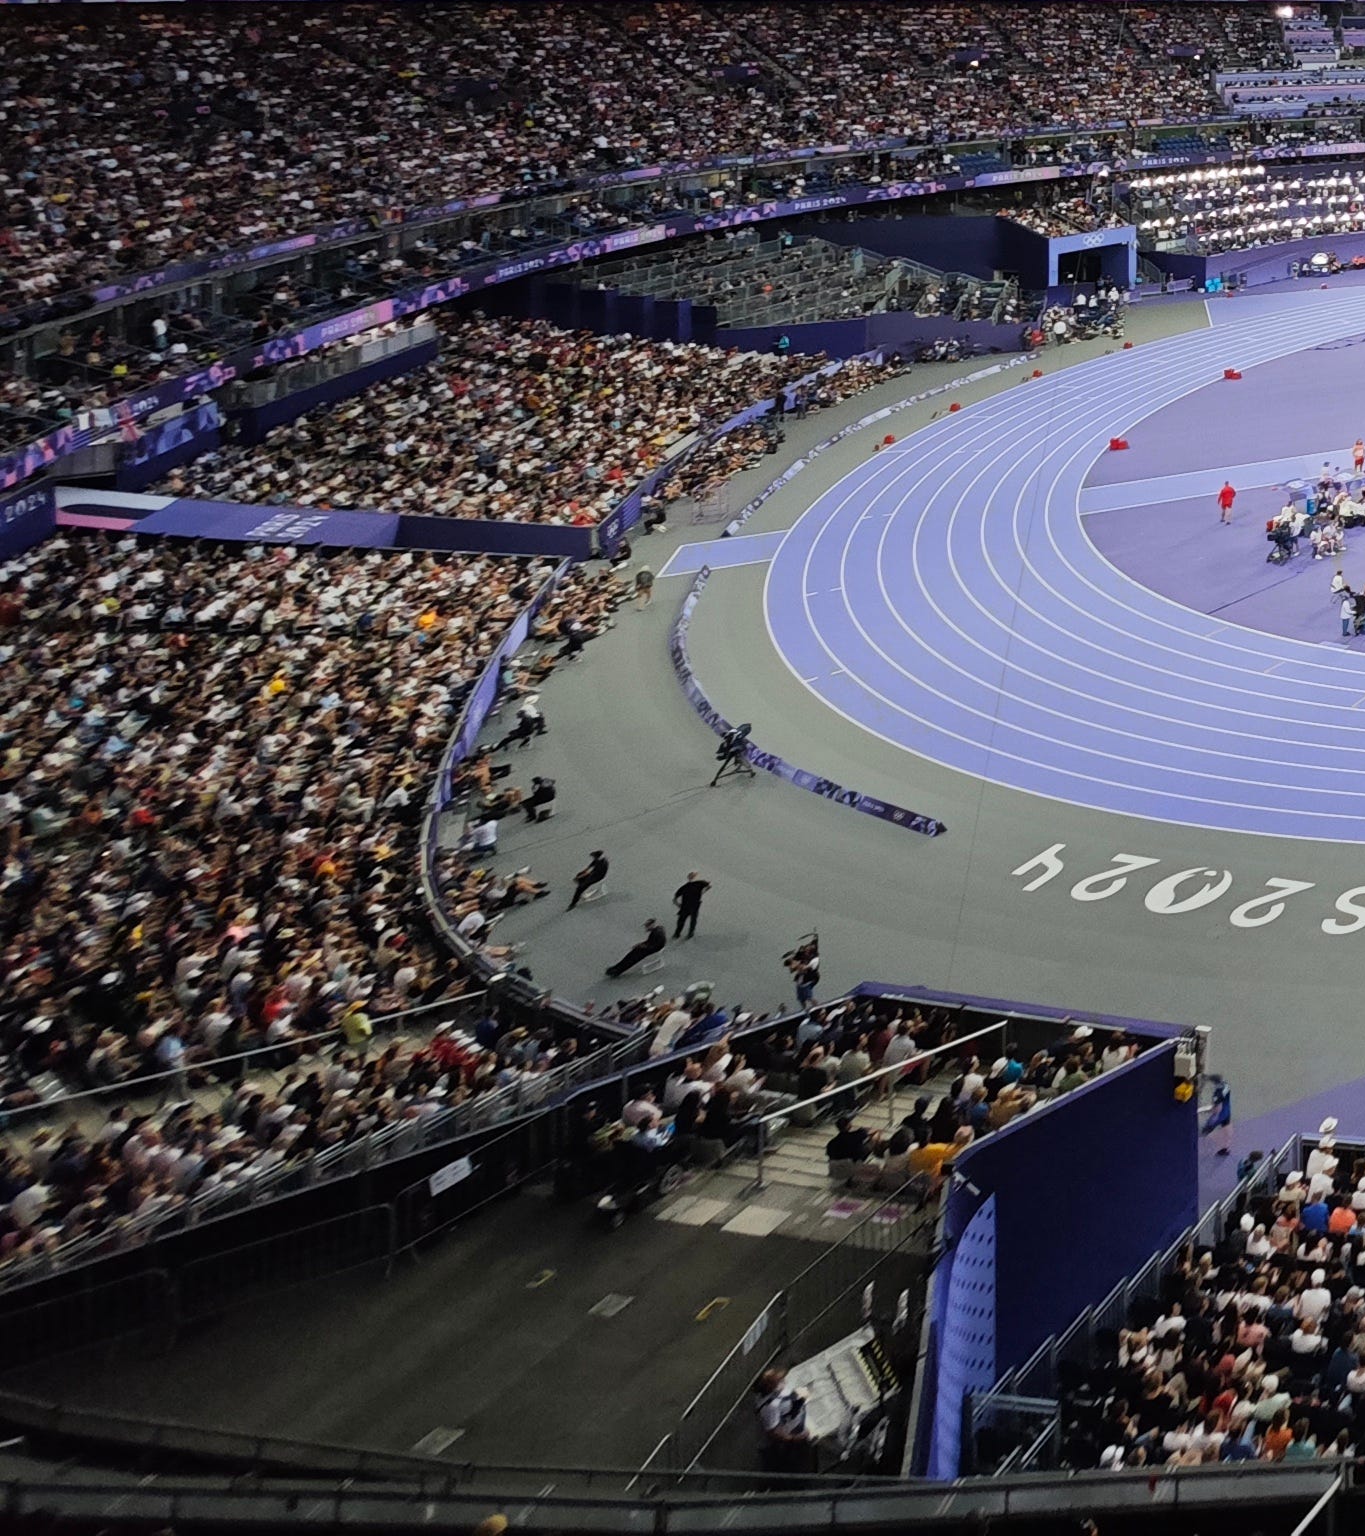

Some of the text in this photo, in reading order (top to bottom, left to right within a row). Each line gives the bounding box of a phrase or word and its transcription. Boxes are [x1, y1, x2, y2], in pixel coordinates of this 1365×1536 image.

[1142, 156, 1190, 167] PARIS 2024
[794, 195, 847, 210] PARIS 2024
[131, 395, 158, 415] 2024
[3, 491, 46, 522] 2024
[244, 512, 301, 538] PARIS
[277, 514, 331, 540] 2024
